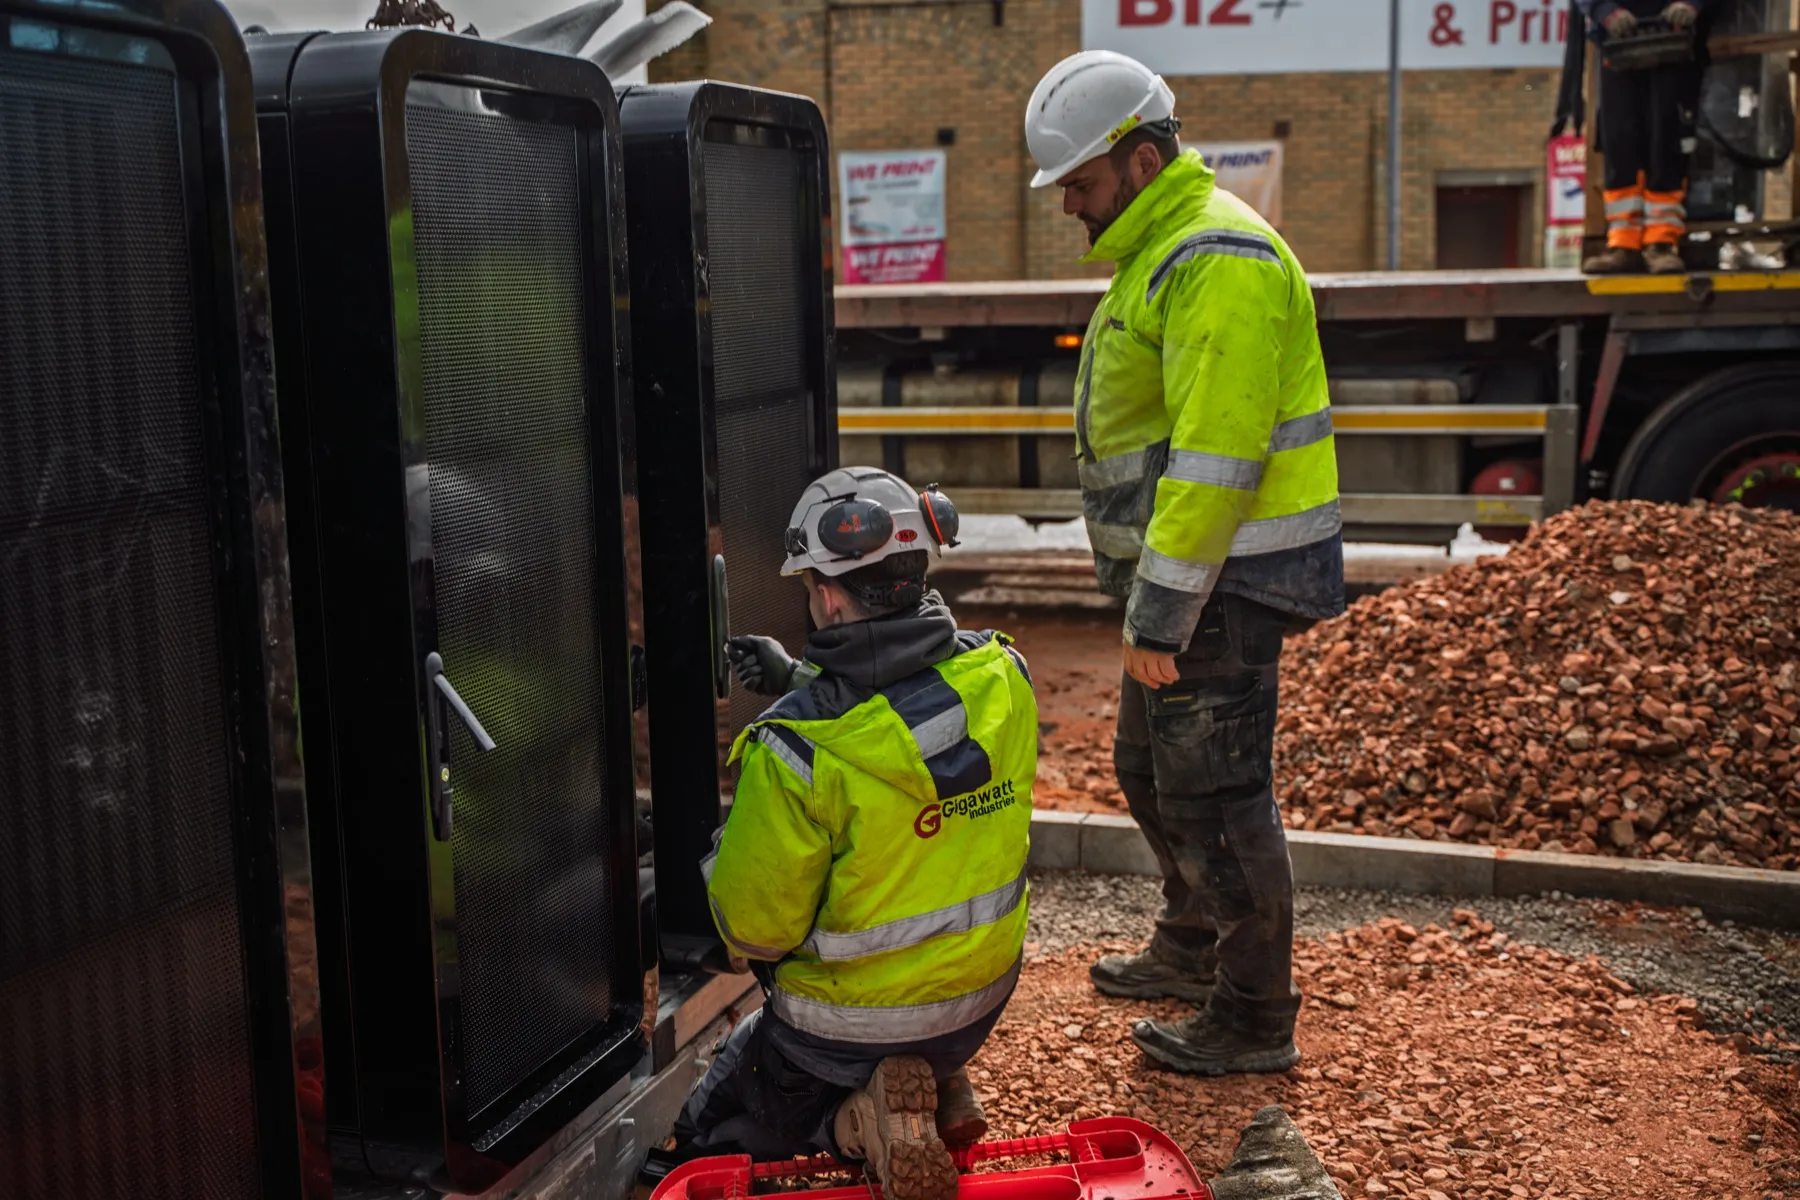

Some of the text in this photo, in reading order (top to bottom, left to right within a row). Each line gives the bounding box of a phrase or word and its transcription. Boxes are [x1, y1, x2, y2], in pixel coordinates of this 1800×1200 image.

[1429, 2, 1464, 46] &
[882, 157, 936, 177] PRINT
[942, 778, 1015, 818] Gigawatt
[968, 796, 1016, 820] industries
